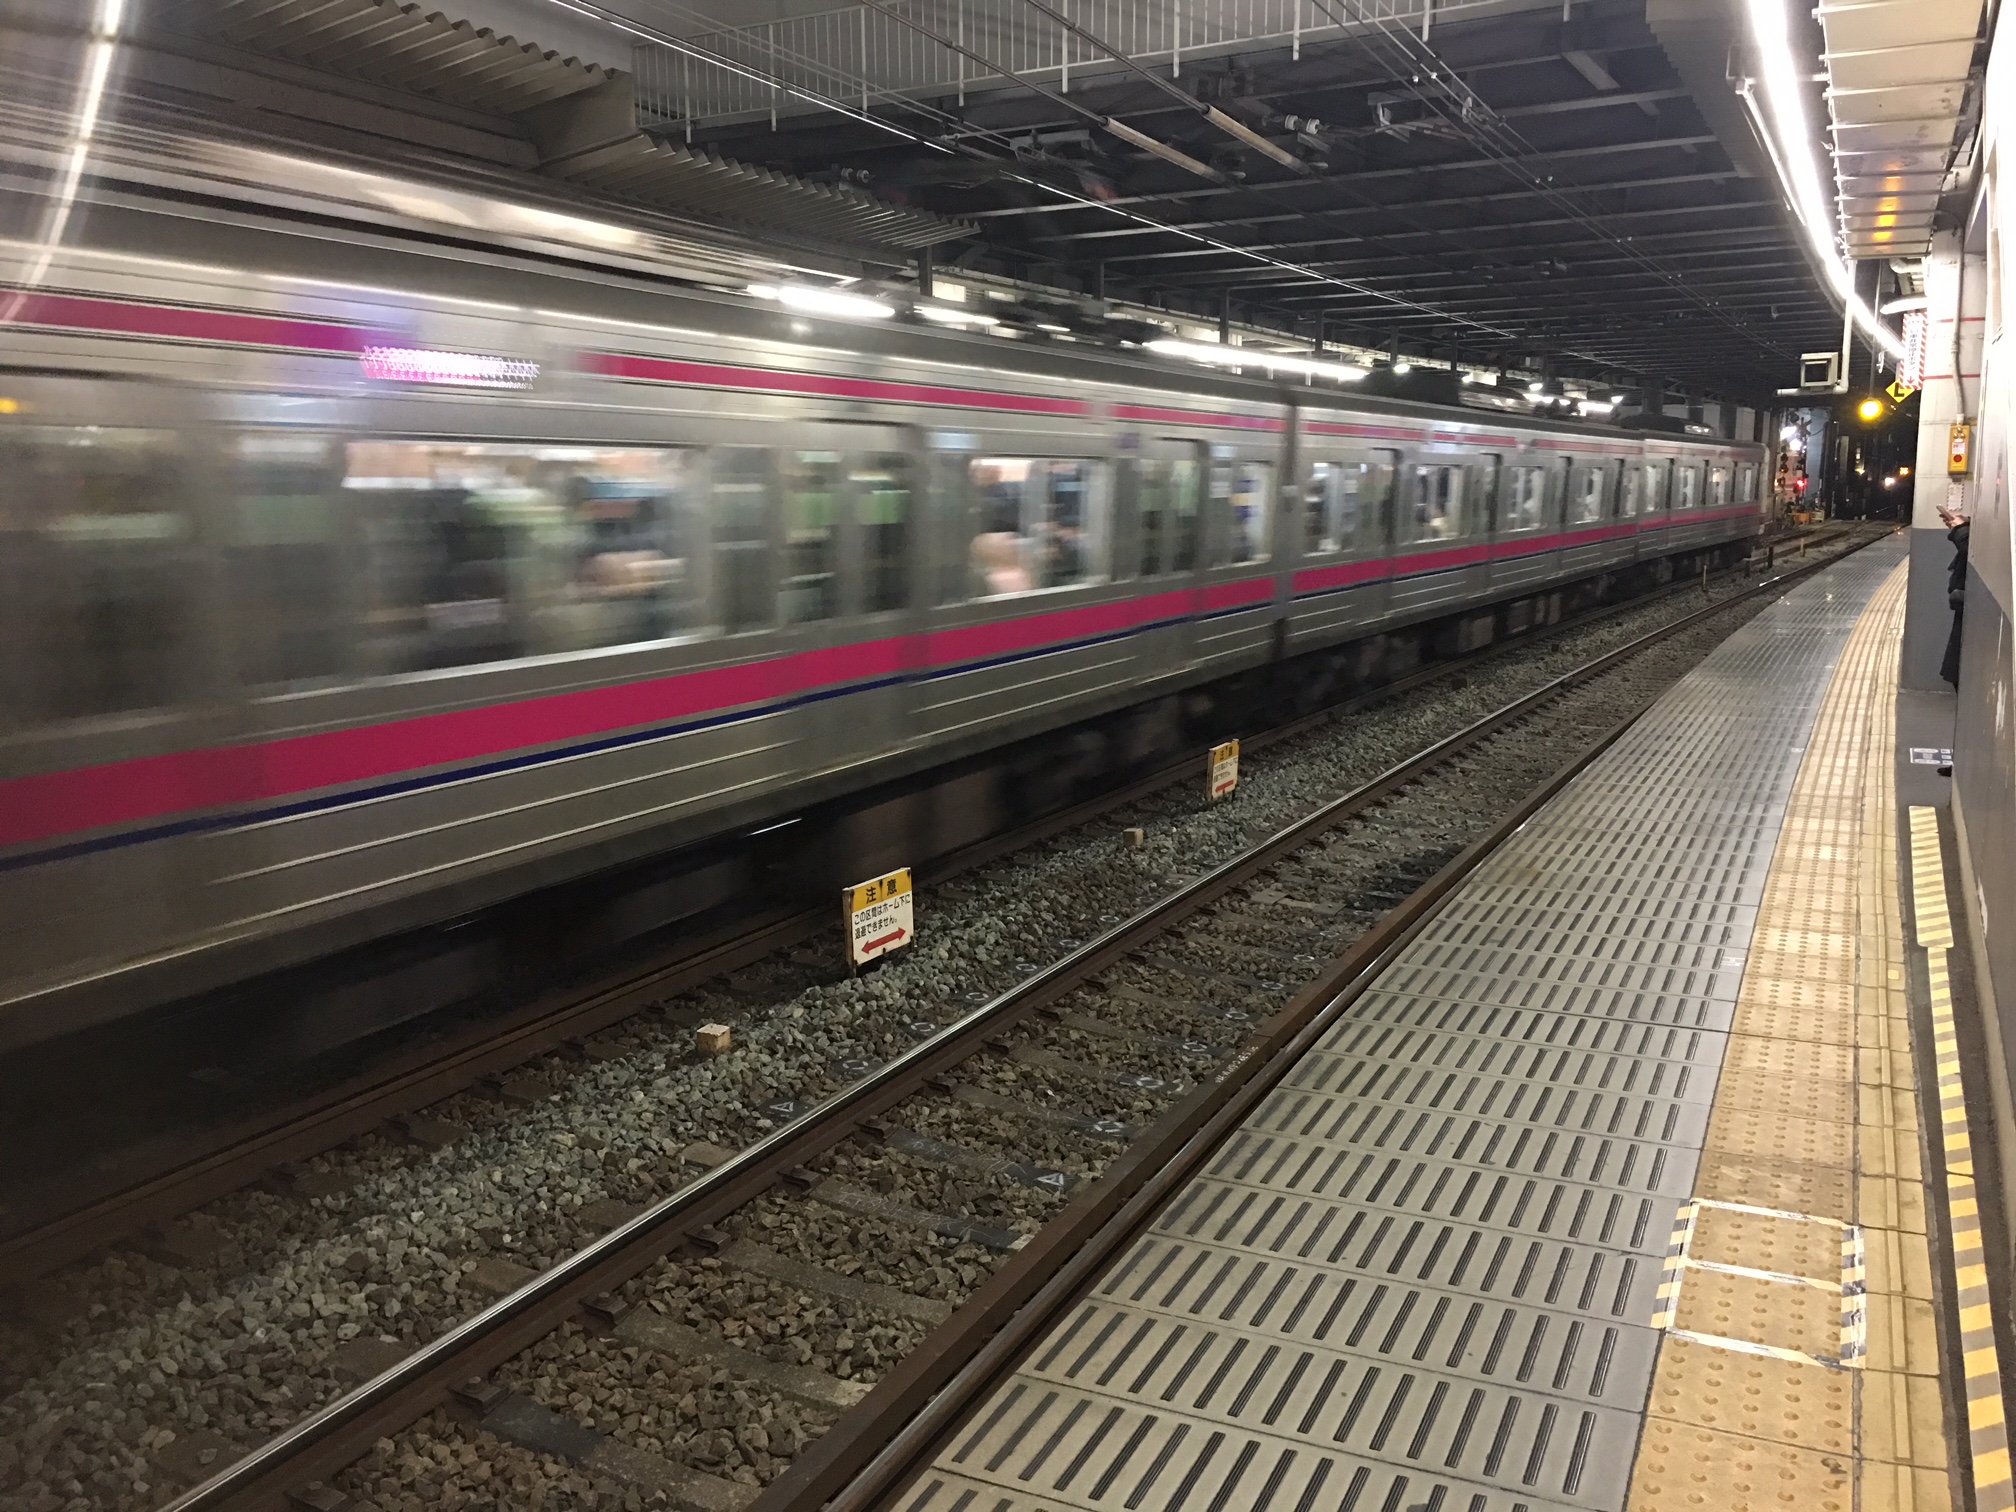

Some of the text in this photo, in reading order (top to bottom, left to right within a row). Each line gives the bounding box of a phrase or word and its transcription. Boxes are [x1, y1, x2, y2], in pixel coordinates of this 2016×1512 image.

[866, 879, 897, 904] 注意
[855, 894, 910, 925] この区間はホーム下に
